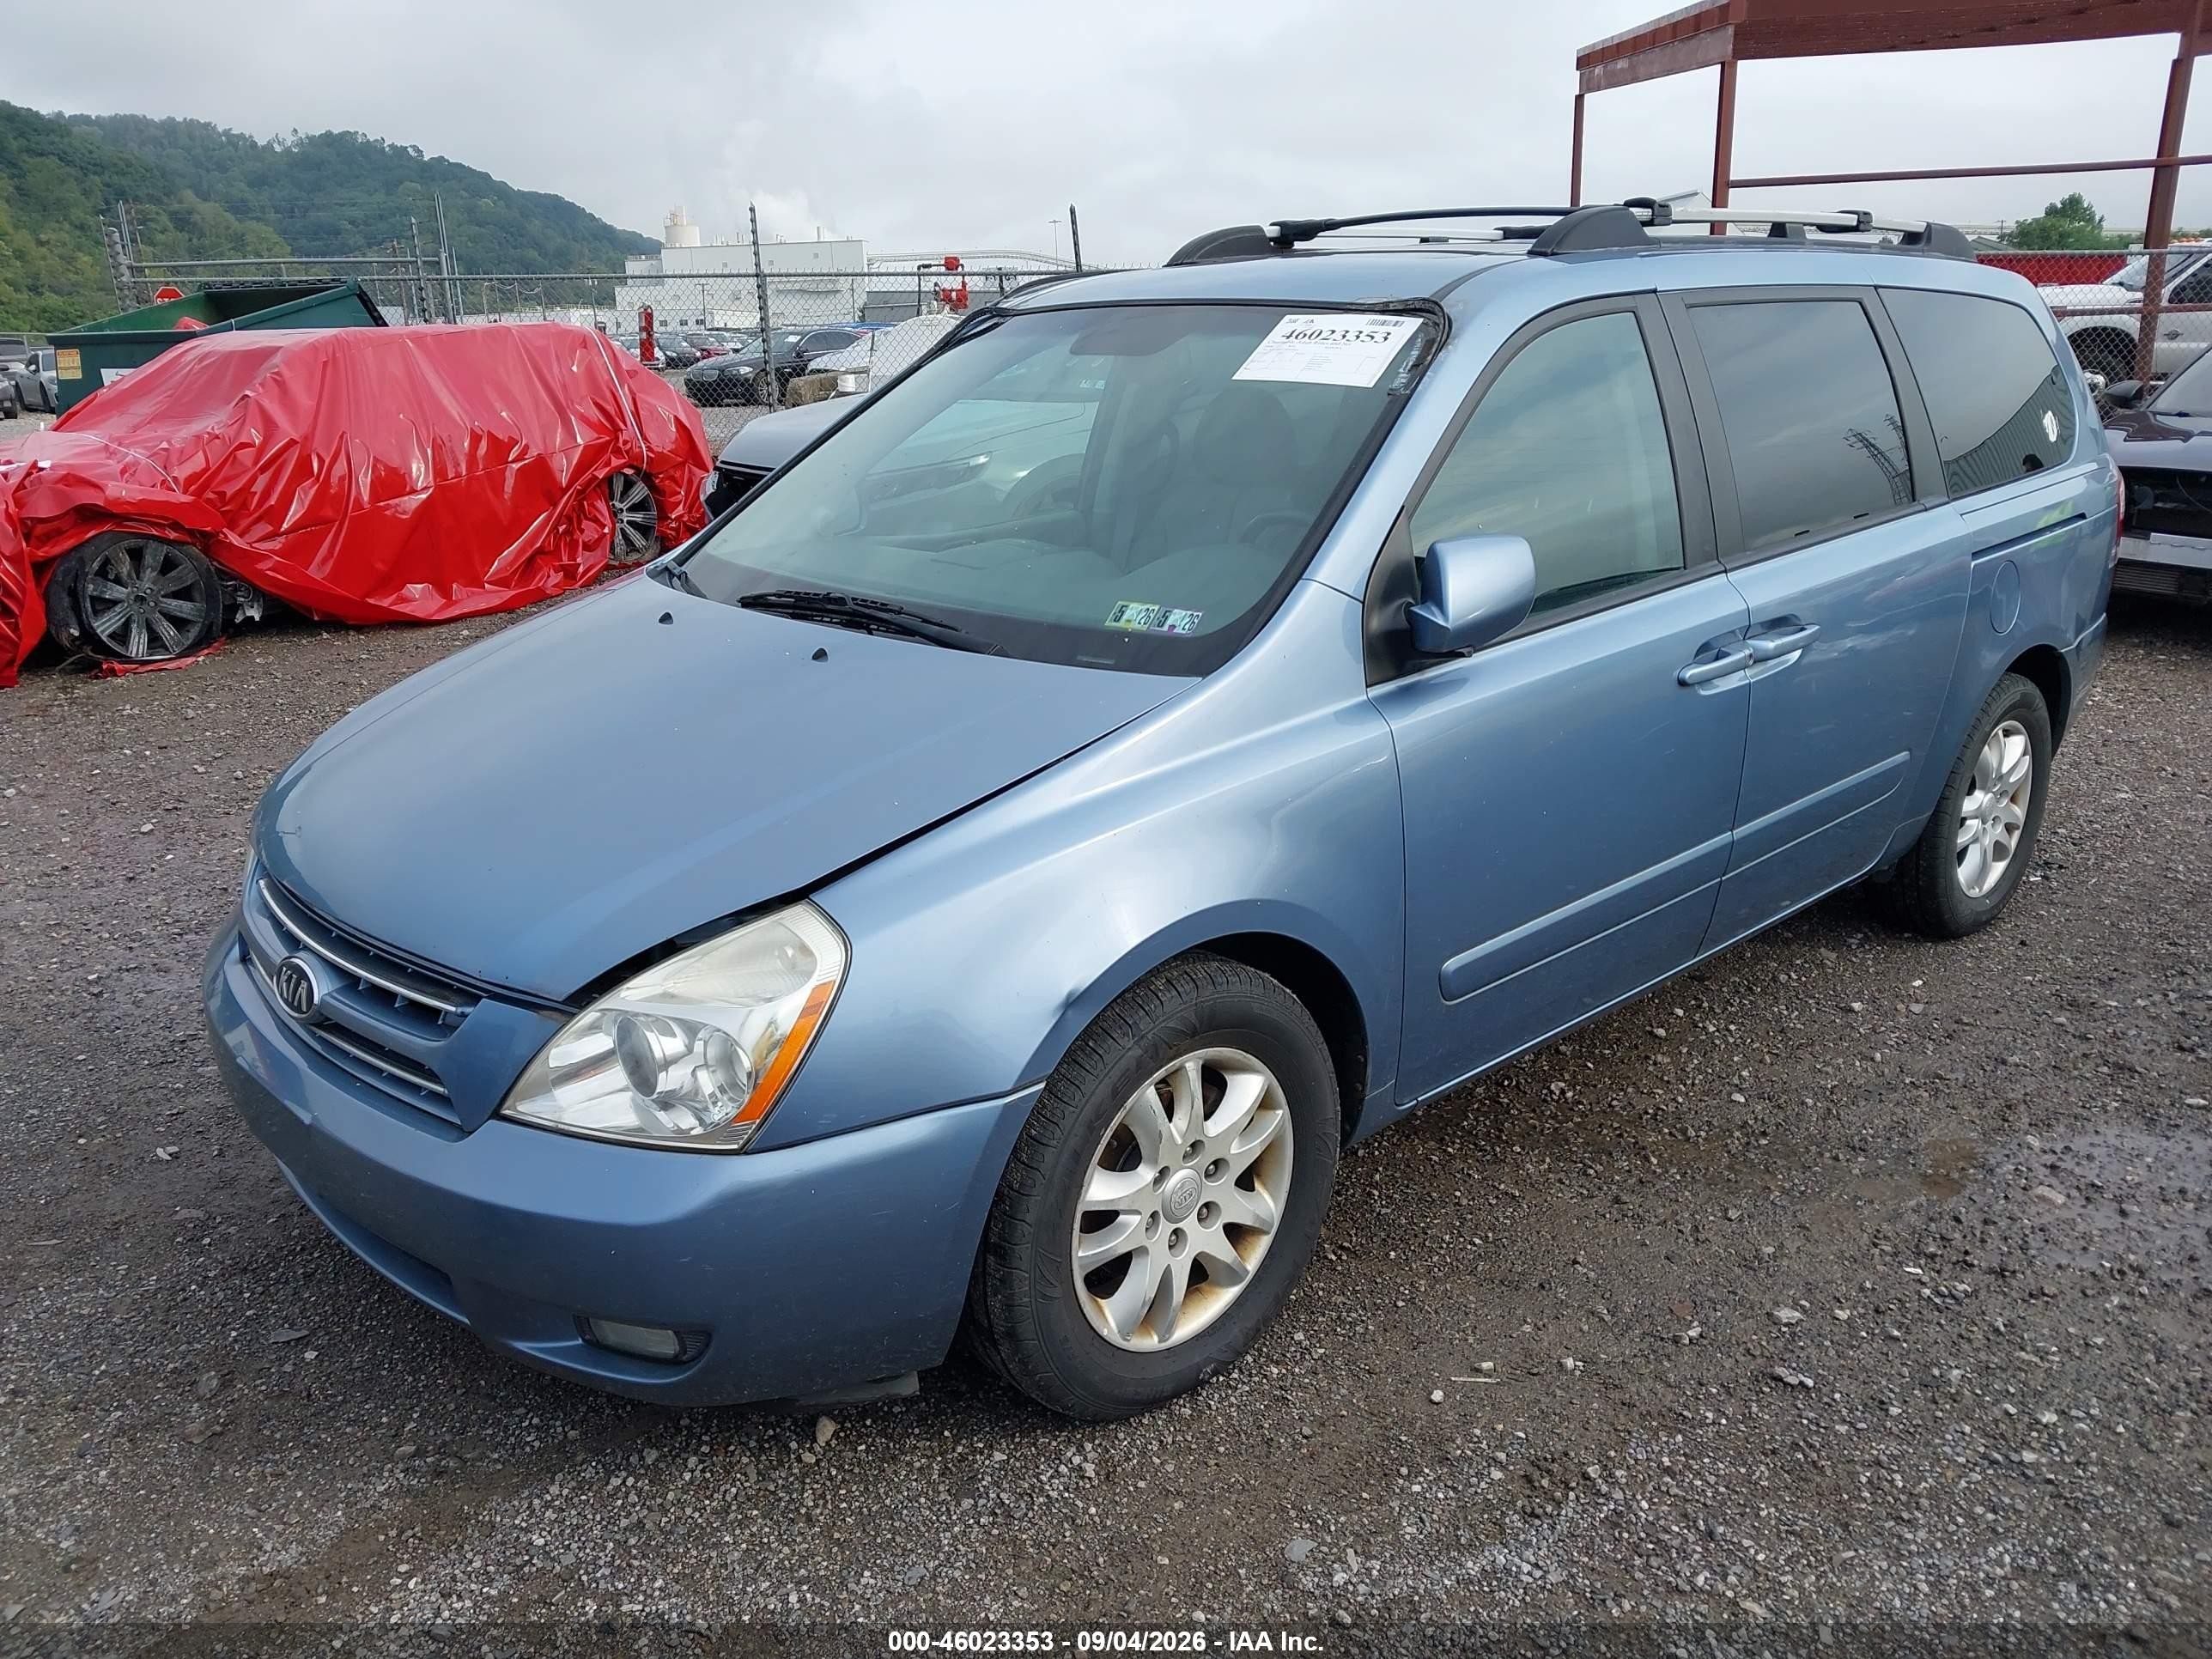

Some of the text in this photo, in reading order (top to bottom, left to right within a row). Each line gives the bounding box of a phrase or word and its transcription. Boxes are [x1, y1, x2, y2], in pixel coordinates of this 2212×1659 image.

[1281, 328, 1391, 343] 46023353
[1113, 605, 1155, 626] 5 26
[1157, 610, 1200, 632] 5 26
